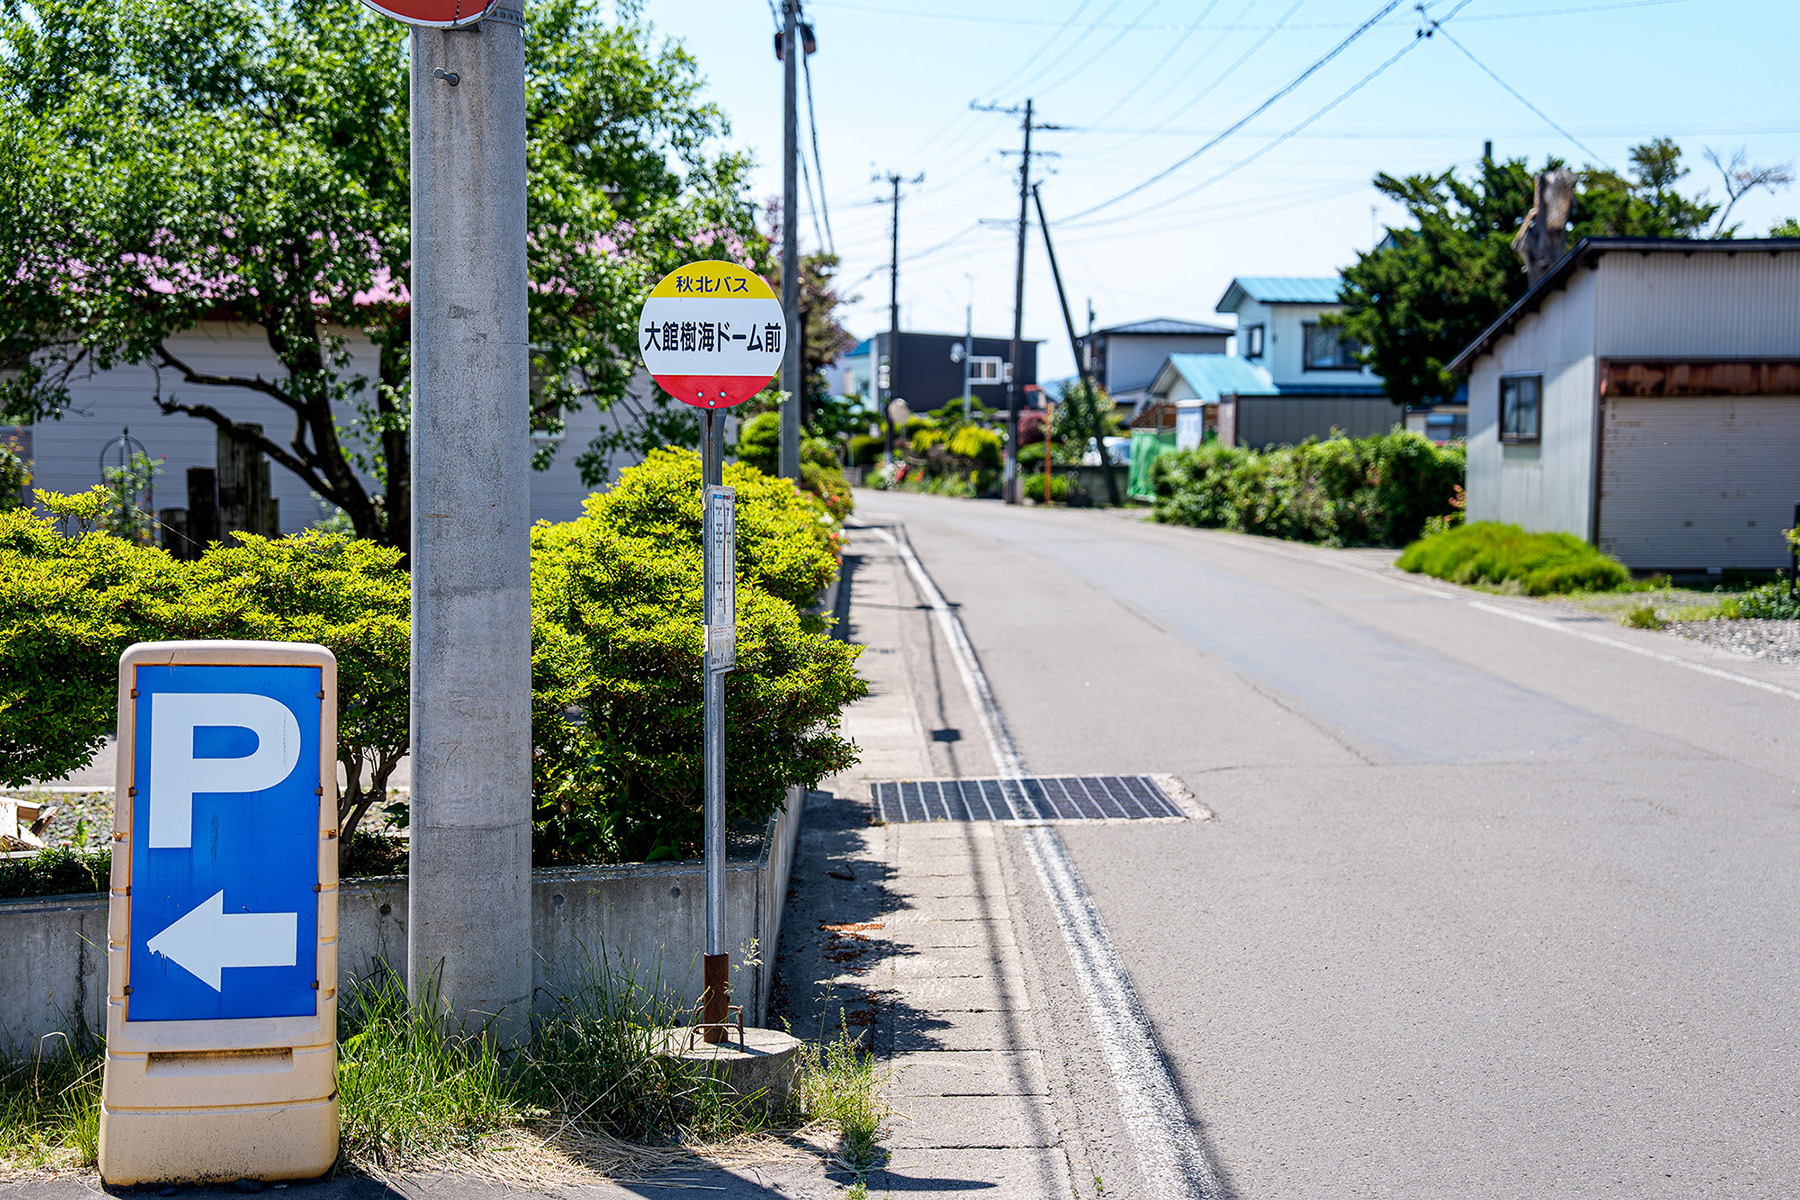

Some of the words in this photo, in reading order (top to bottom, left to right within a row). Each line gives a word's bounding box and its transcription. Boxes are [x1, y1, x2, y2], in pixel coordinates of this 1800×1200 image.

[676, 276, 749, 293] 秋北バス
[644, 321, 782, 353] 大館樹海ドーム前
[148, 692, 302, 849] P
